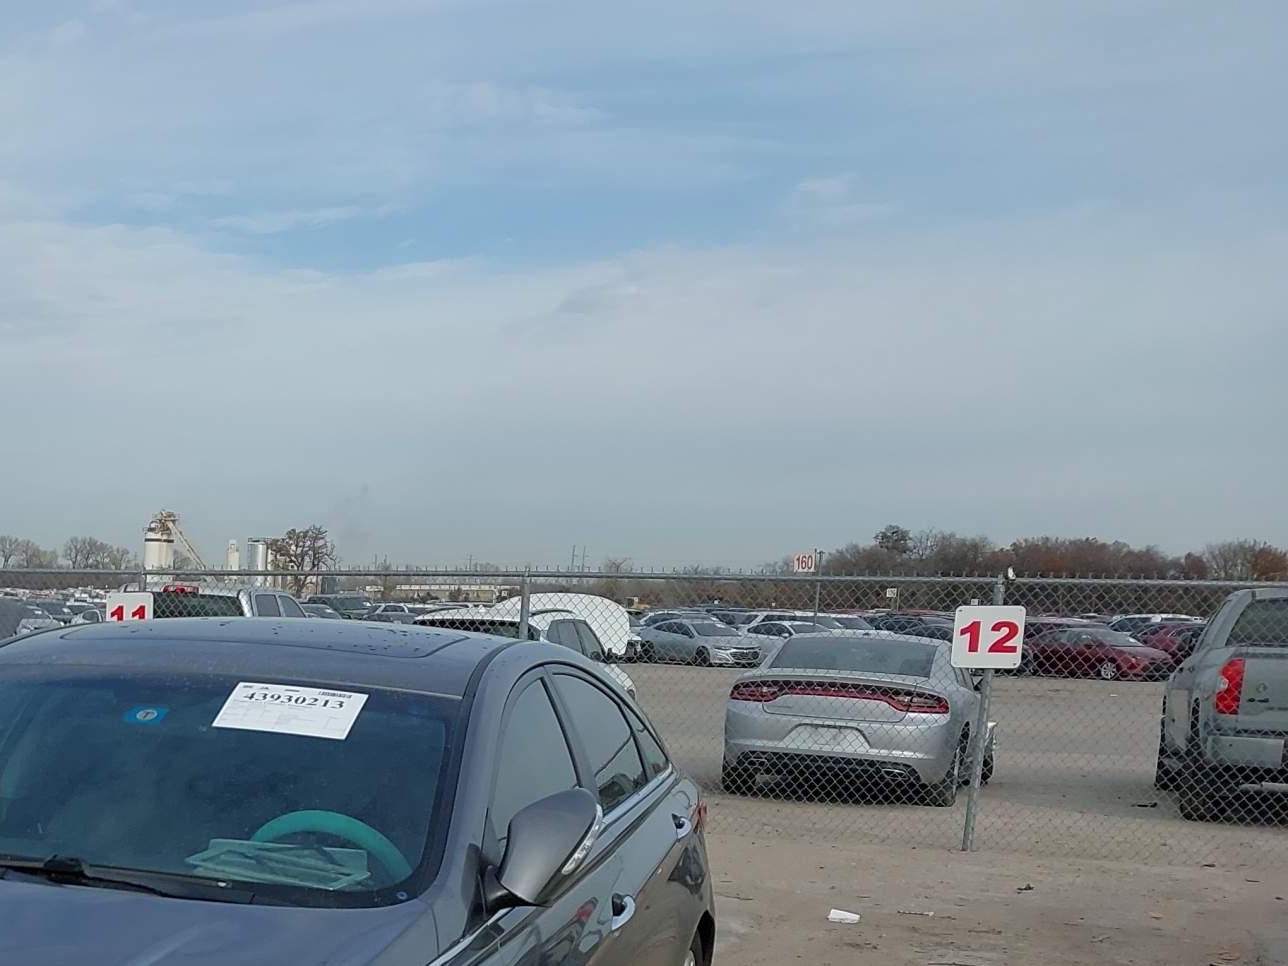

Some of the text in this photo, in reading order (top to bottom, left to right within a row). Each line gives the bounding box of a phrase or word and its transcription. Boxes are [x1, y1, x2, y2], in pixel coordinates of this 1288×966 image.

[795, 554, 814, 570] 160
[110, 604, 147, 621] 11
[959, 620, 1020, 654] 12
[243, 691, 346, 710] 43930213
